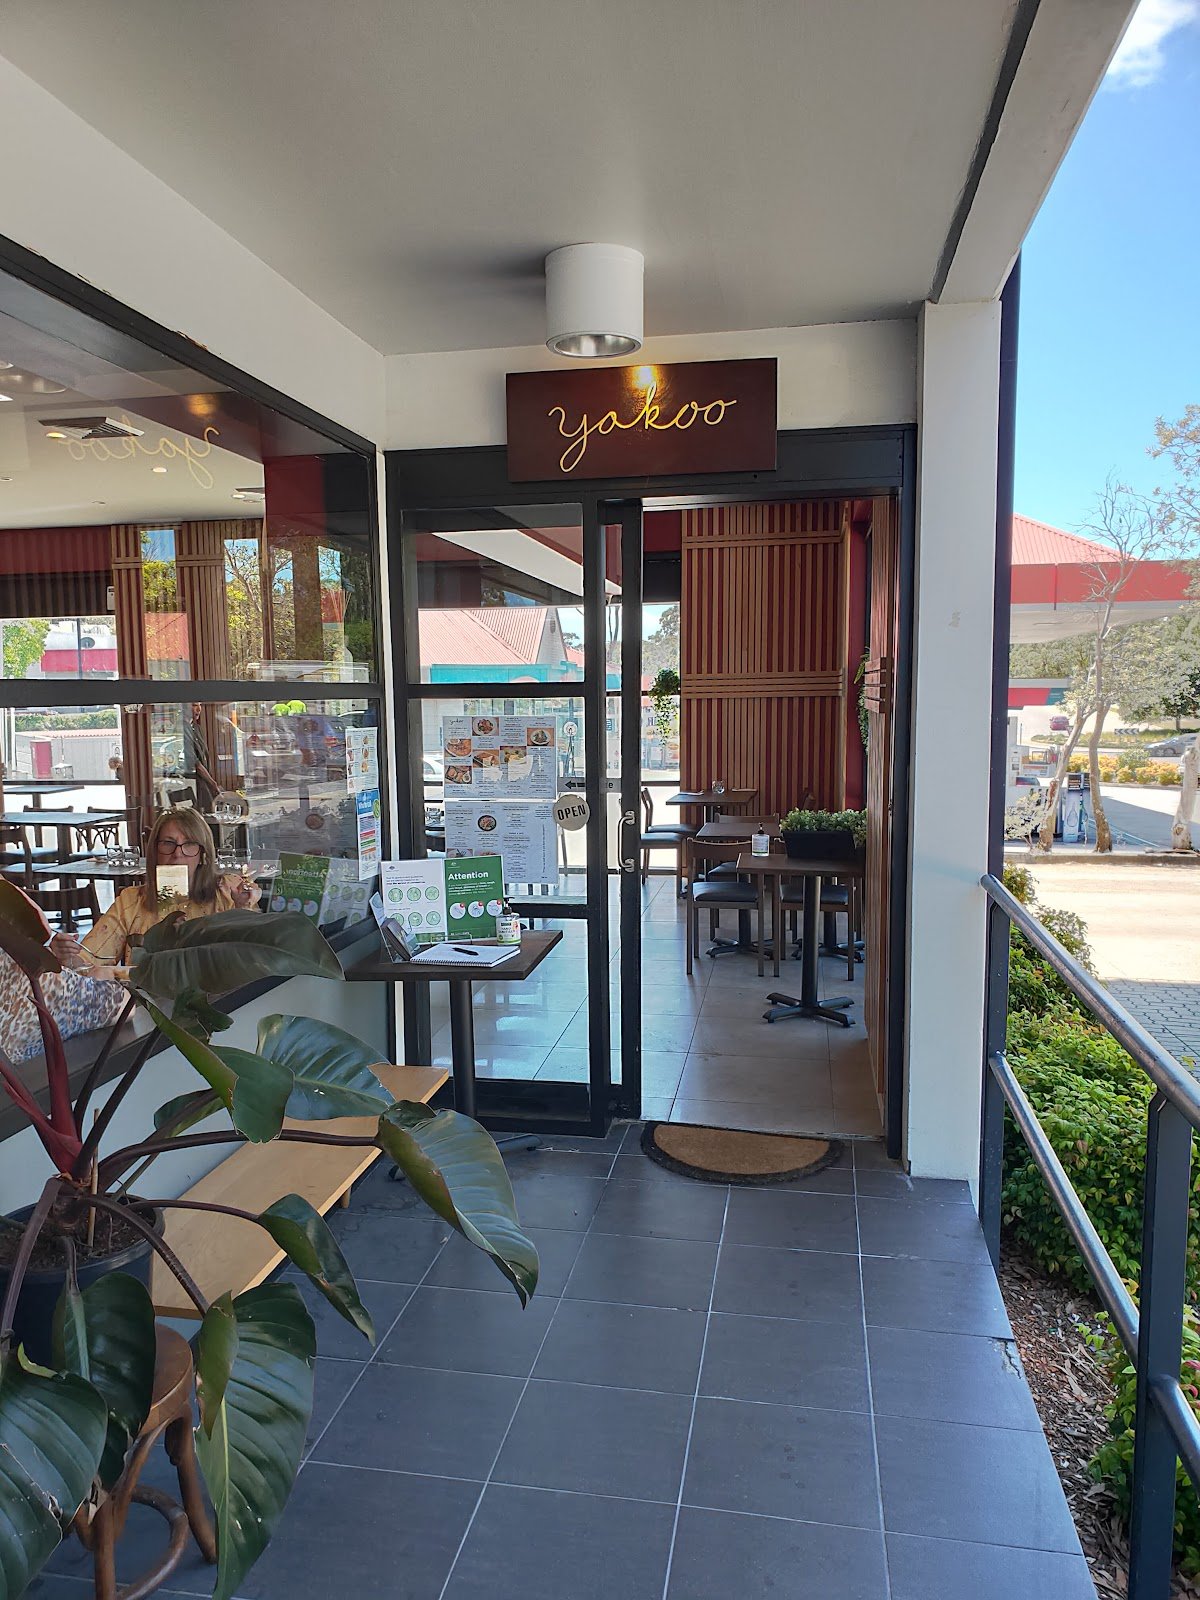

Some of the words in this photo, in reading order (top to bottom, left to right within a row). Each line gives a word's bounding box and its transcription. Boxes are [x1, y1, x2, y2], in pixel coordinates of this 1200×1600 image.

[548, 381, 737, 473] yakoo
[557, 803, 587, 821] OPEN
[447, 871, 489, 881] Attention
